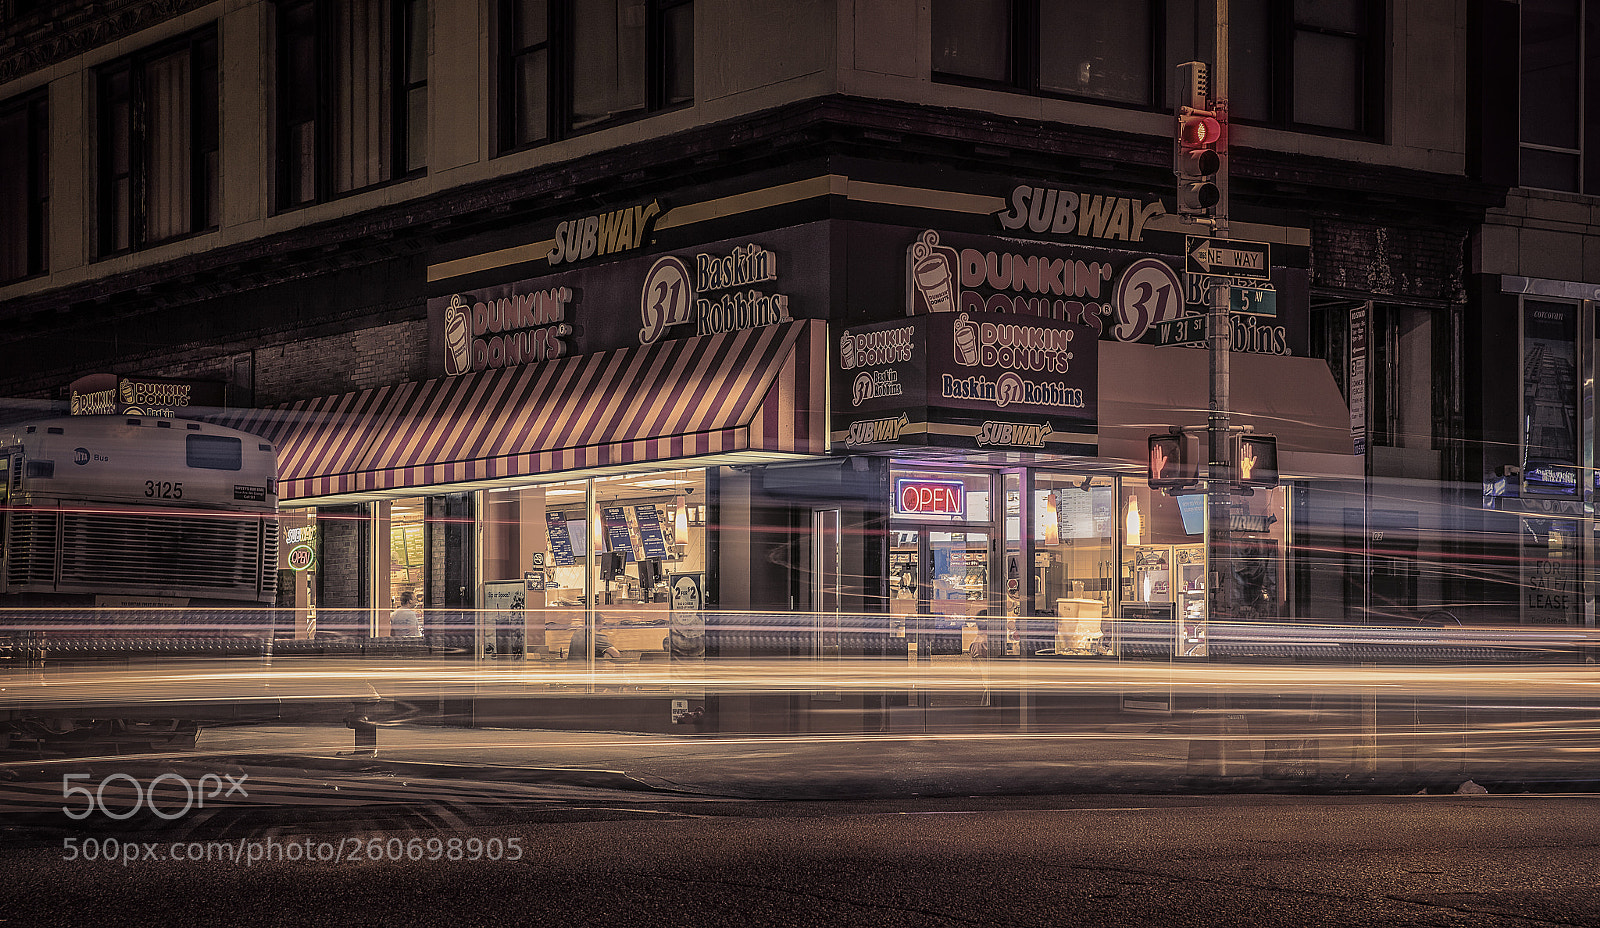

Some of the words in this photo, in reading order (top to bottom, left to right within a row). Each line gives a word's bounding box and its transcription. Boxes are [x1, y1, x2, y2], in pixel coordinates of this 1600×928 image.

[998, 185, 1167, 243] SUBWAY
[547, 200, 661, 266] SUBWAY
[1234, 252, 1258, 267] WAY
[961, 248, 1112, 298] DUNKIN'
[641, 270, 687, 345] 31
[696, 243, 773, 293] Baskin
[1241, 289, 1250, 311] 5
[1254, 291, 1264, 302] AV
[472, 286, 567, 336] DUNKIN'
[1114, 274, 1175, 342] 31
[856, 325, 915, 351] DUNKIN'
[981, 322, 1075, 351] DUNKIN'
[1160, 323, 1171, 344] W
[1175, 321, 1189, 342] 31
[1193, 318, 1203, 331] ST
[472, 326, 561, 371] DONUTS
[856, 343, 912, 368] DONUTS
[981, 345, 1069, 374] DONUTS
[81, 389, 116, 408] DUNKIN'
[136, 383, 191, 396] DUNKIN'
[136, 394, 190, 406] DONUTS
[852, 378, 872, 407] 31
[942, 374, 997, 401] Baskin
[998, 378, 1021, 407] 31
[846, 413, 909, 448] SUBWAY
[976, 421, 1053, 447] SUBWAY
[94, 454, 108, 462] Bus
[145, 480, 183, 499] 3125
[902, 486, 960, 513] OPEN
[286, 525, 317, 544] SUBWAY
[1229, 513, 1277, 533] UBWAY
[292, 551, 311, 564] OPEN
[1010, 557, 1018, 573] A
[1536, 560, 1561, 575] FOR
[675, 587, 681, 600] 2
[1528, 594, 1569, 609] LEASE
